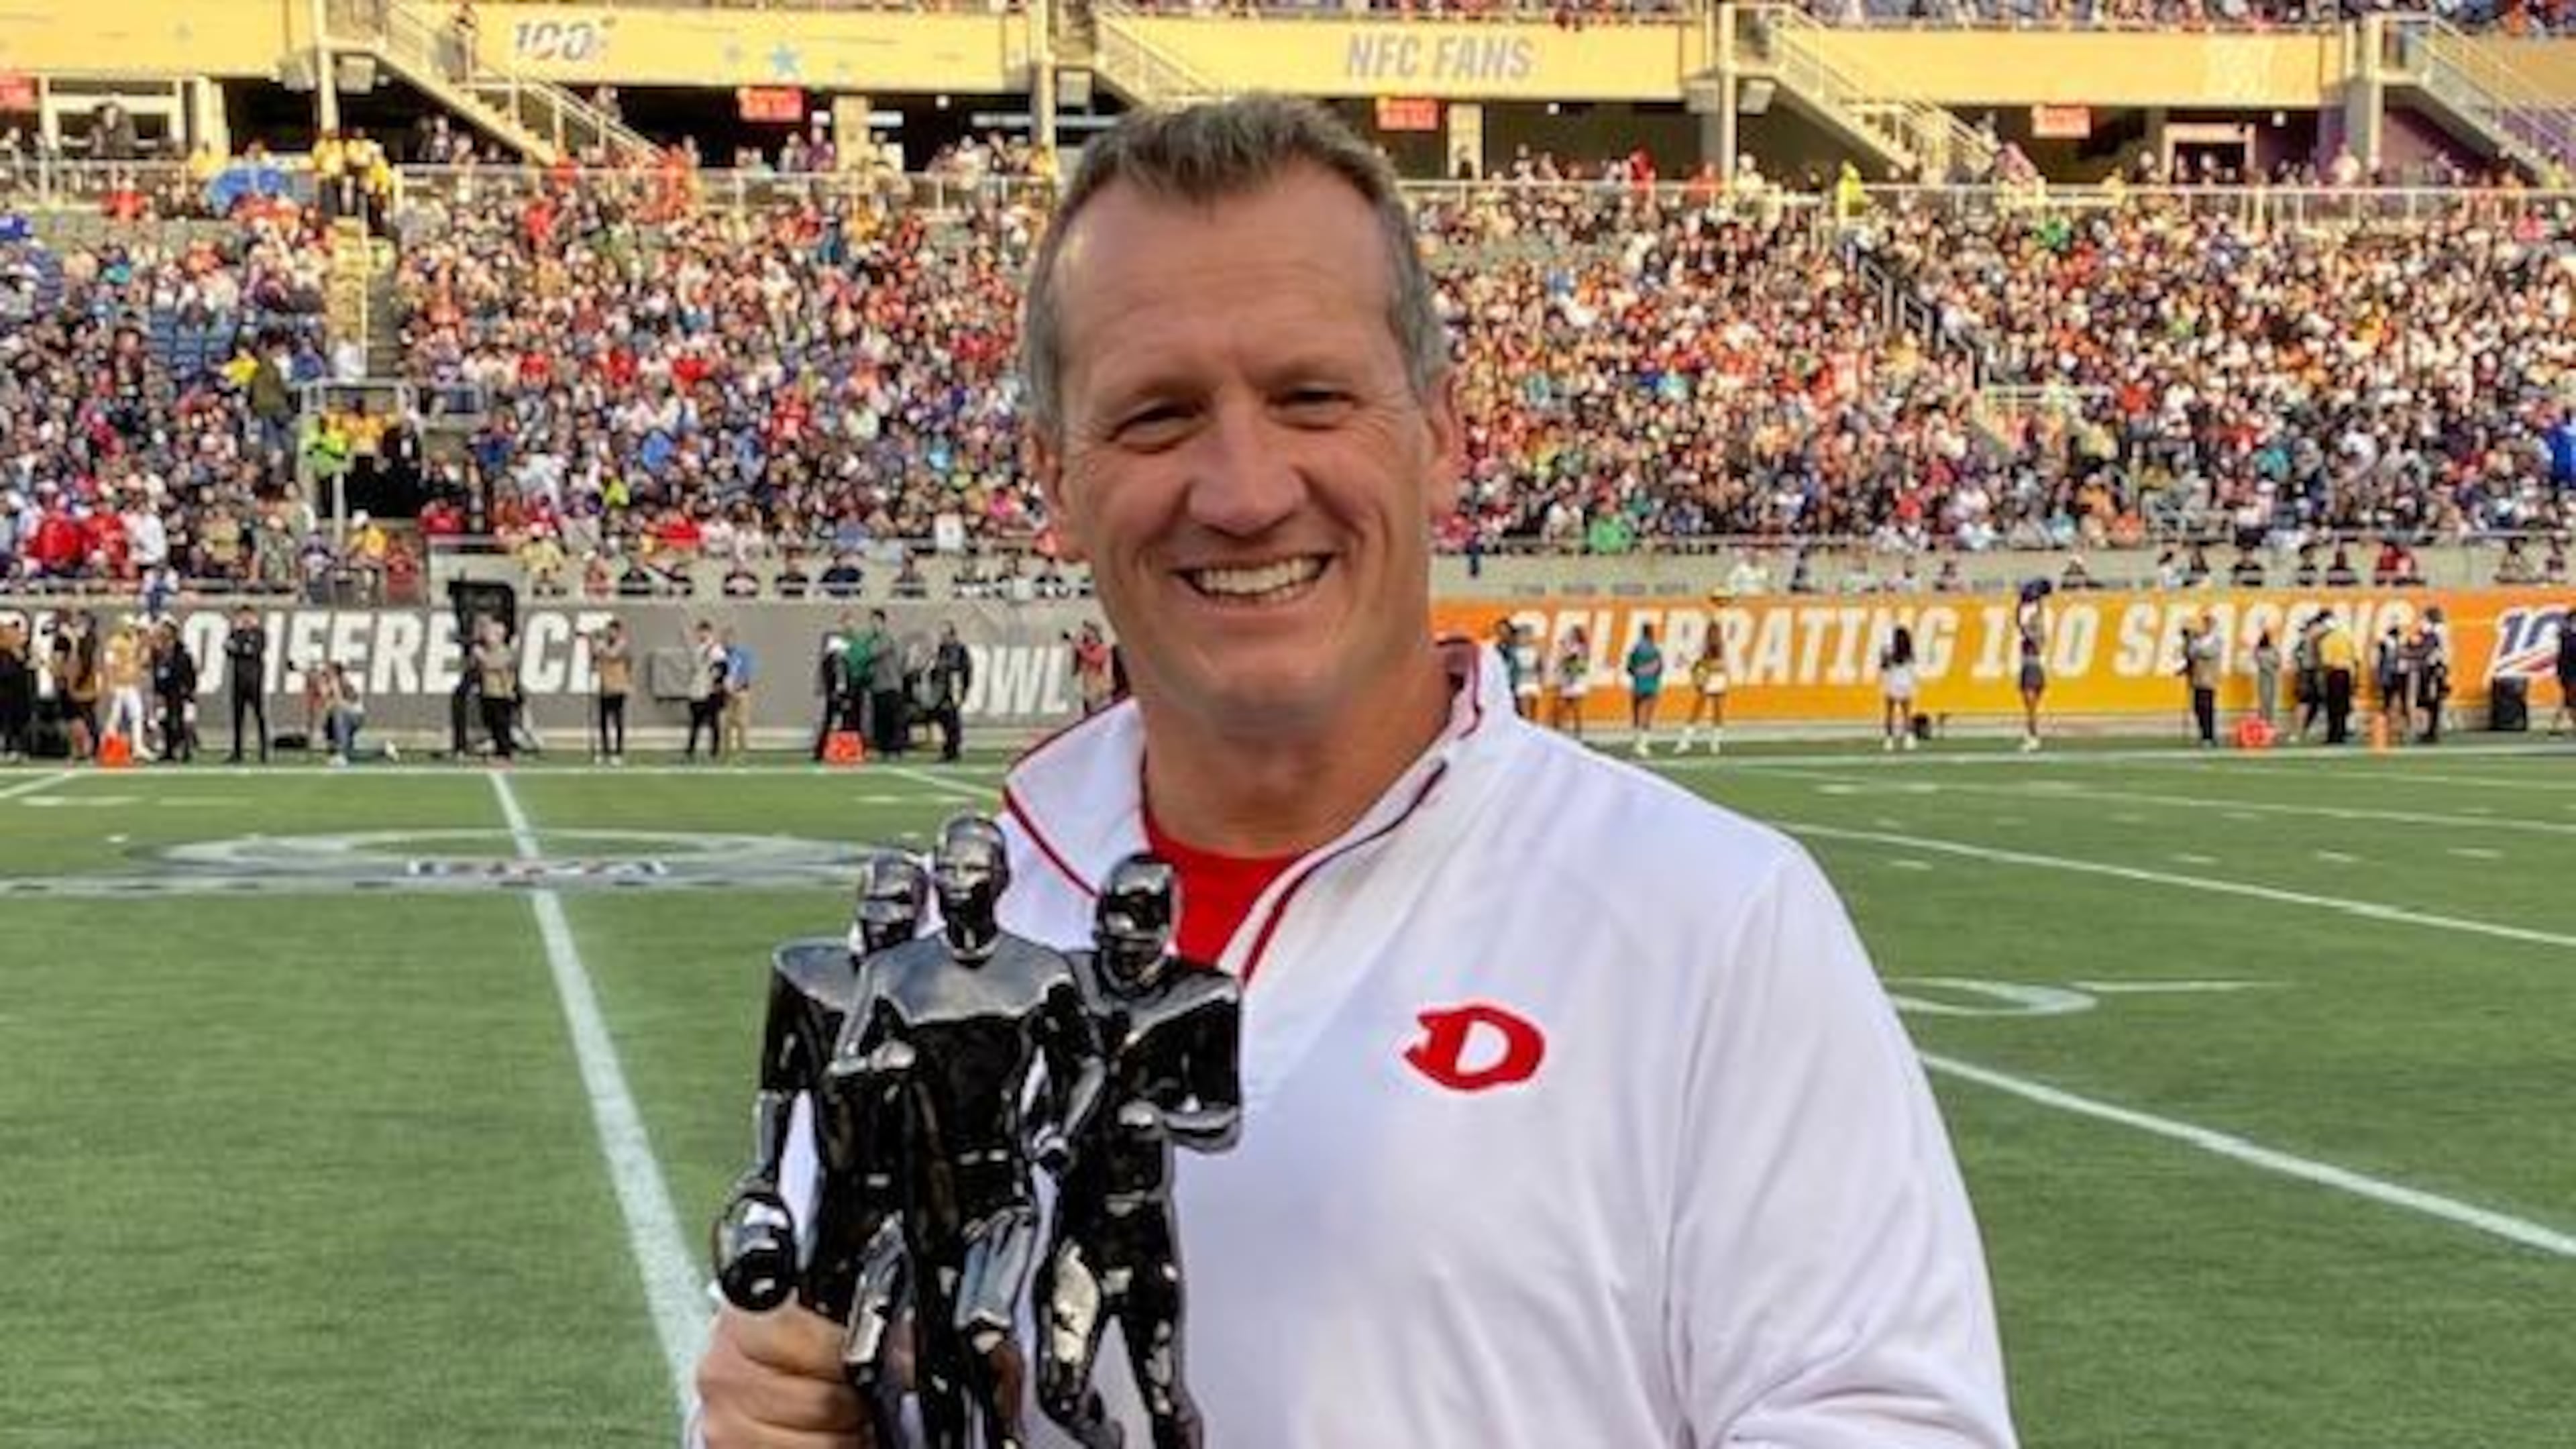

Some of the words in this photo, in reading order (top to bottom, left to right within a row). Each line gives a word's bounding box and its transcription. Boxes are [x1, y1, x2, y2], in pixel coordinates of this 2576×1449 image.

[1348, 32, 1421, 79] NFC
[1432, 35, 1535, 81] FANS
[136, 609, 613, 694] OFERECE
[1404, 1004, 1546, 1091] D
